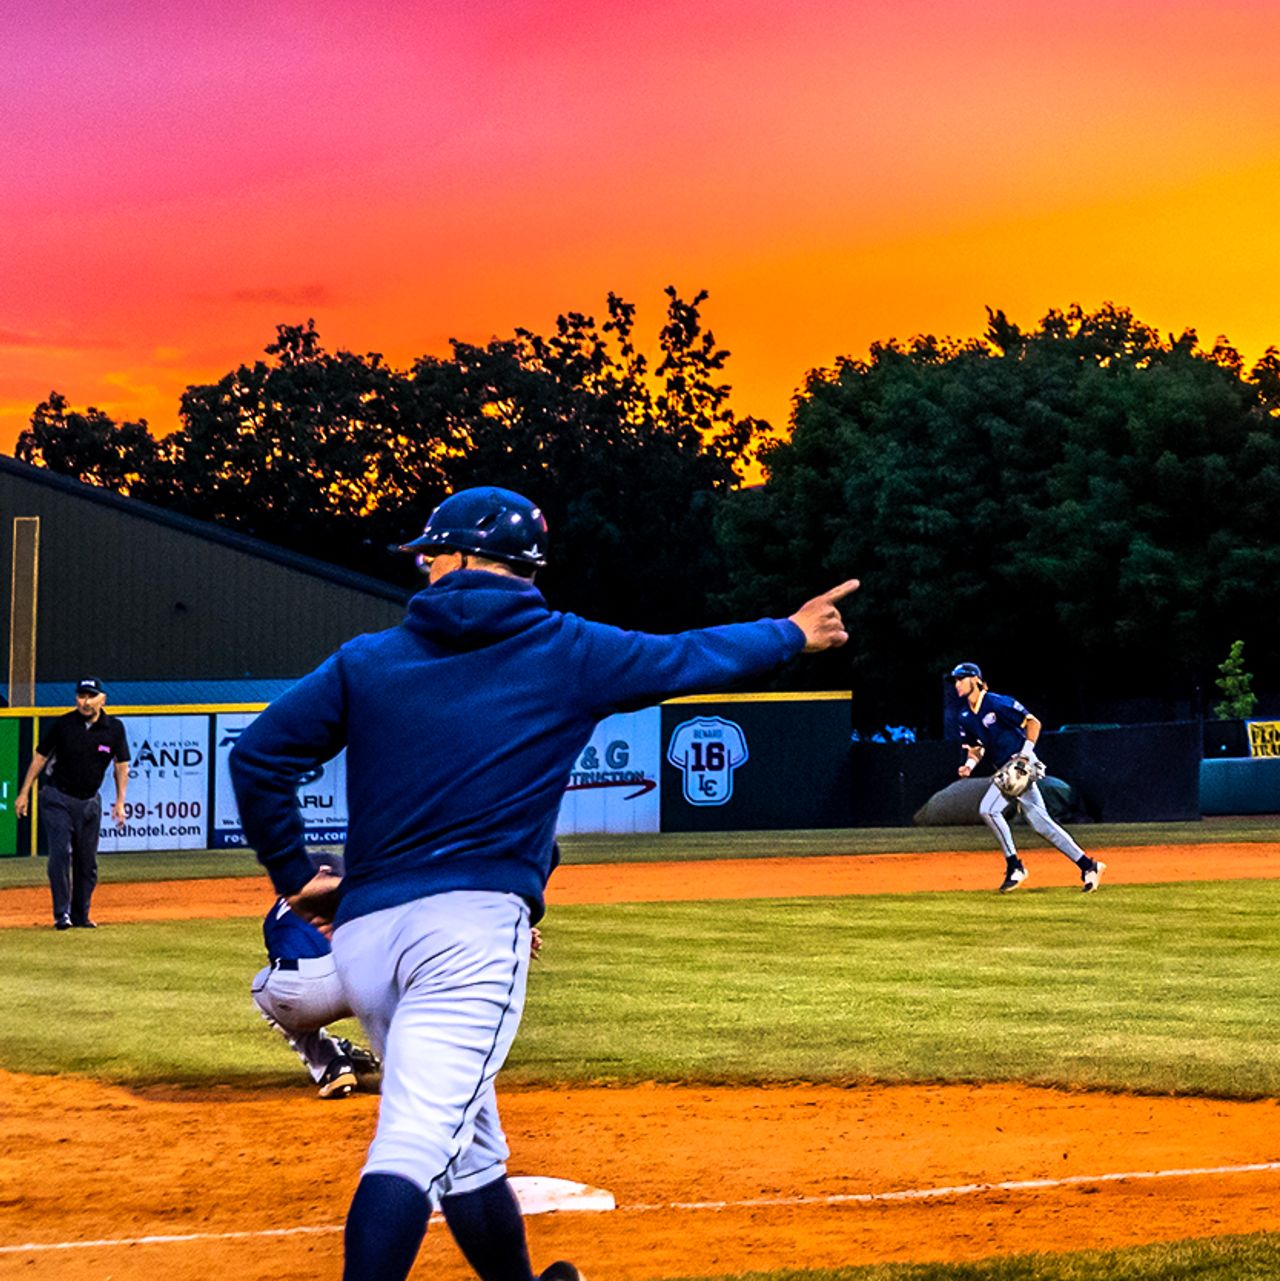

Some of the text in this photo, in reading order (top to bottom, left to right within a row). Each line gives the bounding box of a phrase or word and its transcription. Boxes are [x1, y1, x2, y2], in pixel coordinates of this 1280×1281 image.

[129, 740, 203, 768] AND
[153, 740, 200, 748] CANYON
[605, 740, 630, 770] G
[691, 742, 725, 772] 16
[127, 770, 180, 779] OTEL
